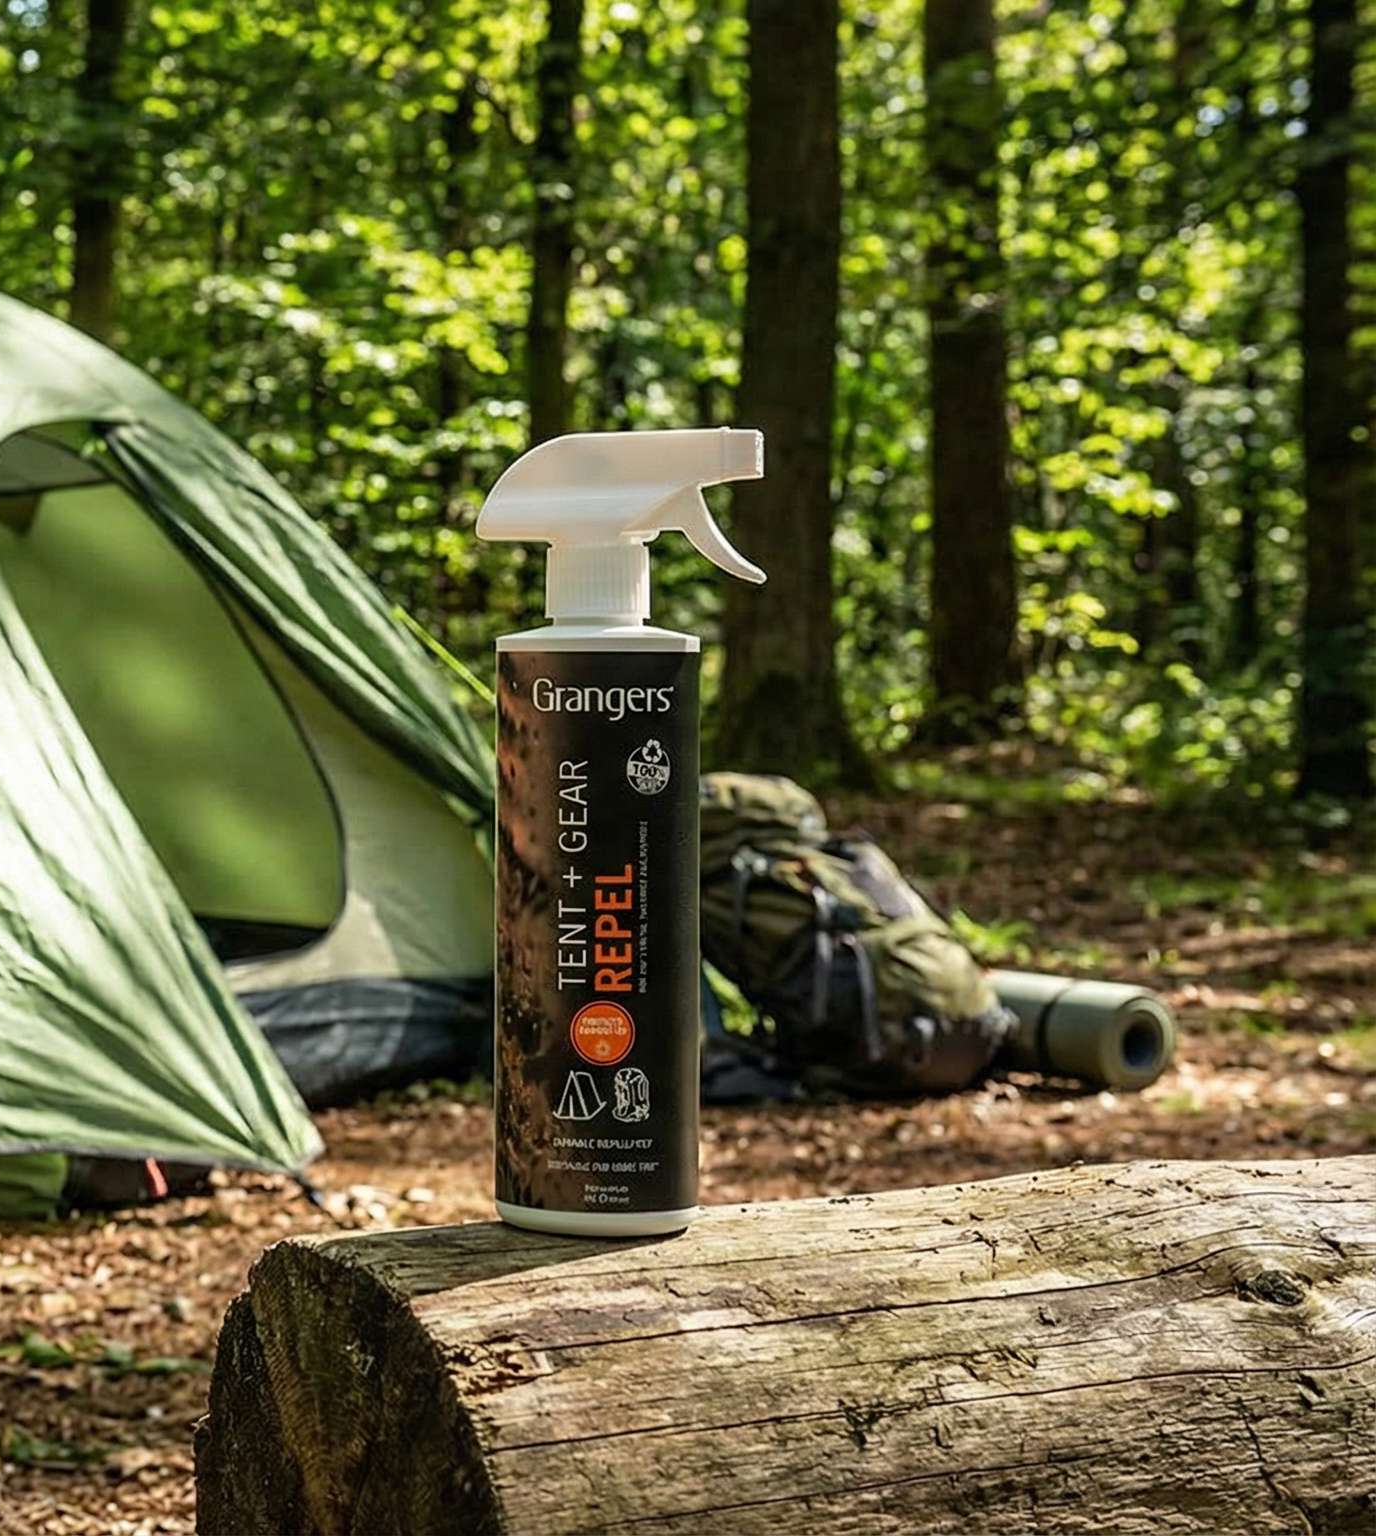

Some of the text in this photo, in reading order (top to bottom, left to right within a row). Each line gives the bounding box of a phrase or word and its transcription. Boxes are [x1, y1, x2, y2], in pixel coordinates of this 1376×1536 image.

[532, 677, 673, 721] Grangers
[558, 760, 589, 990] TENT + GEAR
[594, 864, 633, 992] REPEL
